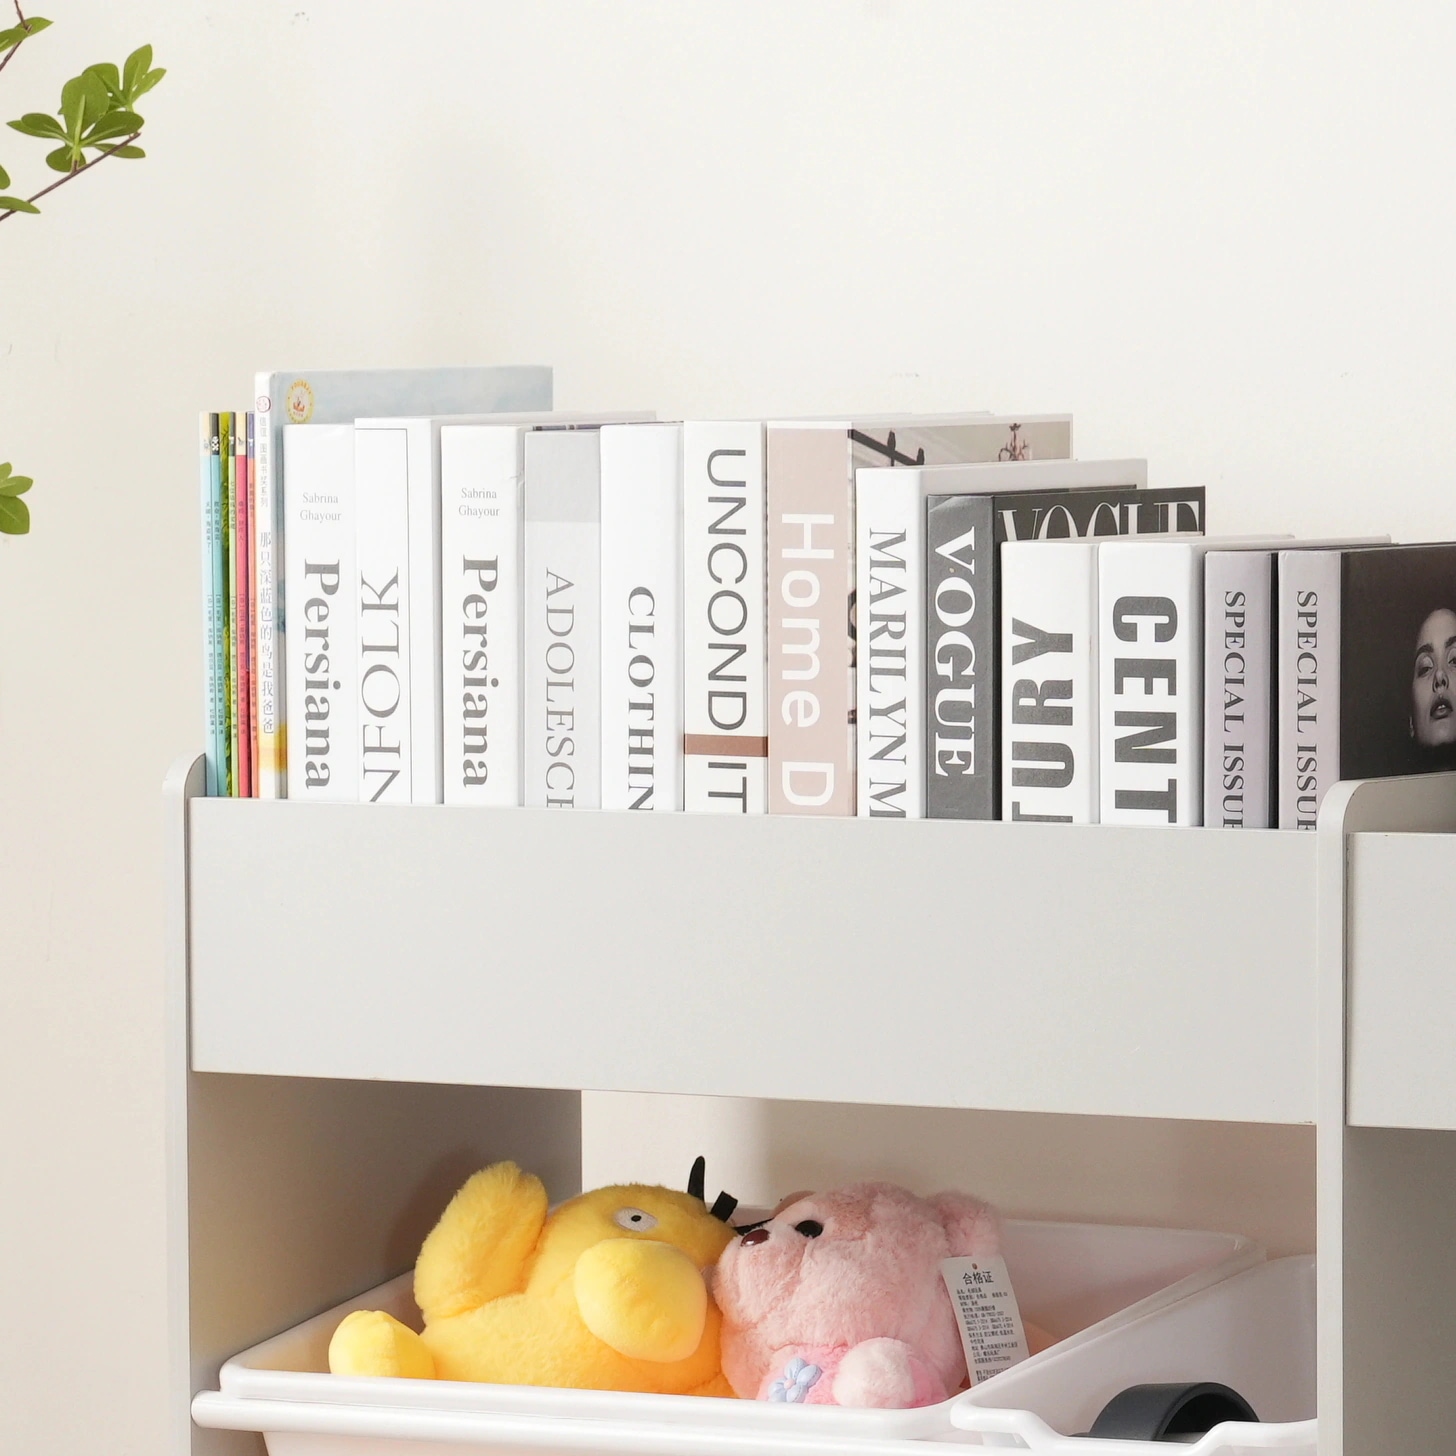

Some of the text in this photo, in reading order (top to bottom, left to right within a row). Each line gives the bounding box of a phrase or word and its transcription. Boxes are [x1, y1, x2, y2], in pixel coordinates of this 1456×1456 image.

[299, 509, 342, 524] Ghayour
[302, 492, 340, 504] Sabrina
[458, 505, 500, 520] Ghayour
[461, 487, 498, 500] Sabrina
[259, 531, 275, 736] 那只深蓝色的鸟是我爸爸
[303, 558, 342, 789] Persiana
[462, 554, 500, 788] Persiana
[627, 586, 655, 810] CLOTHIN
[781, 513, 835, 806] Home D
[868, 528, 907, 817] MARILYN M
[934, 526, 976, 777] VOGUE
[1112, 595, 1178, 823] CENT
[1223, 591, 1246, 733] SPECIAL
[1296, 590, 1318, 734] SPECIAL
[962, 1271, 994, 1285] 合格证
